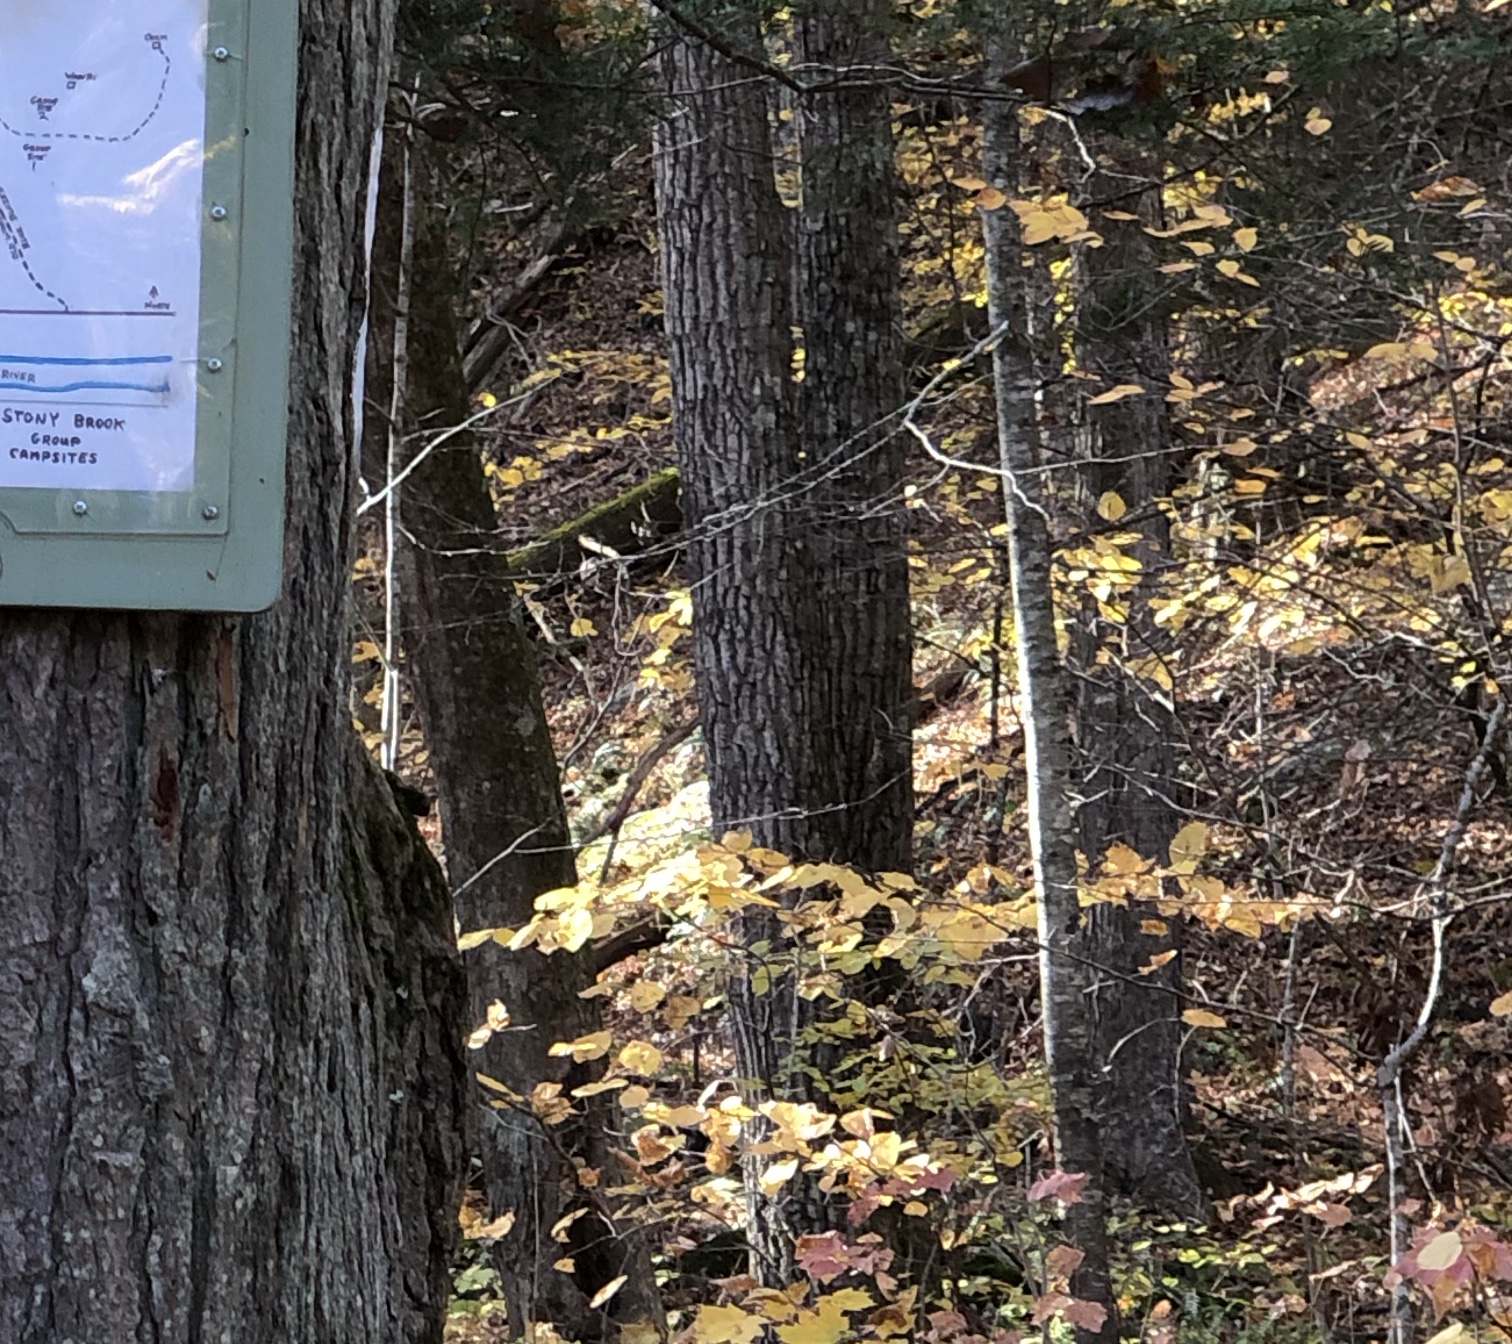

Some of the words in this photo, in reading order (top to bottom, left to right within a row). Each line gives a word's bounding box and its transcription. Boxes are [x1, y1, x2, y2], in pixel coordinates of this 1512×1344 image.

[1, 368, 36, 383] RIVER
[1, 408, 60, 427] STONY
[74, 413, 126, 430] BROOK
[31, 432, 81, 447] GROUP
[9, 448, 98, 464] CAMPSITES
